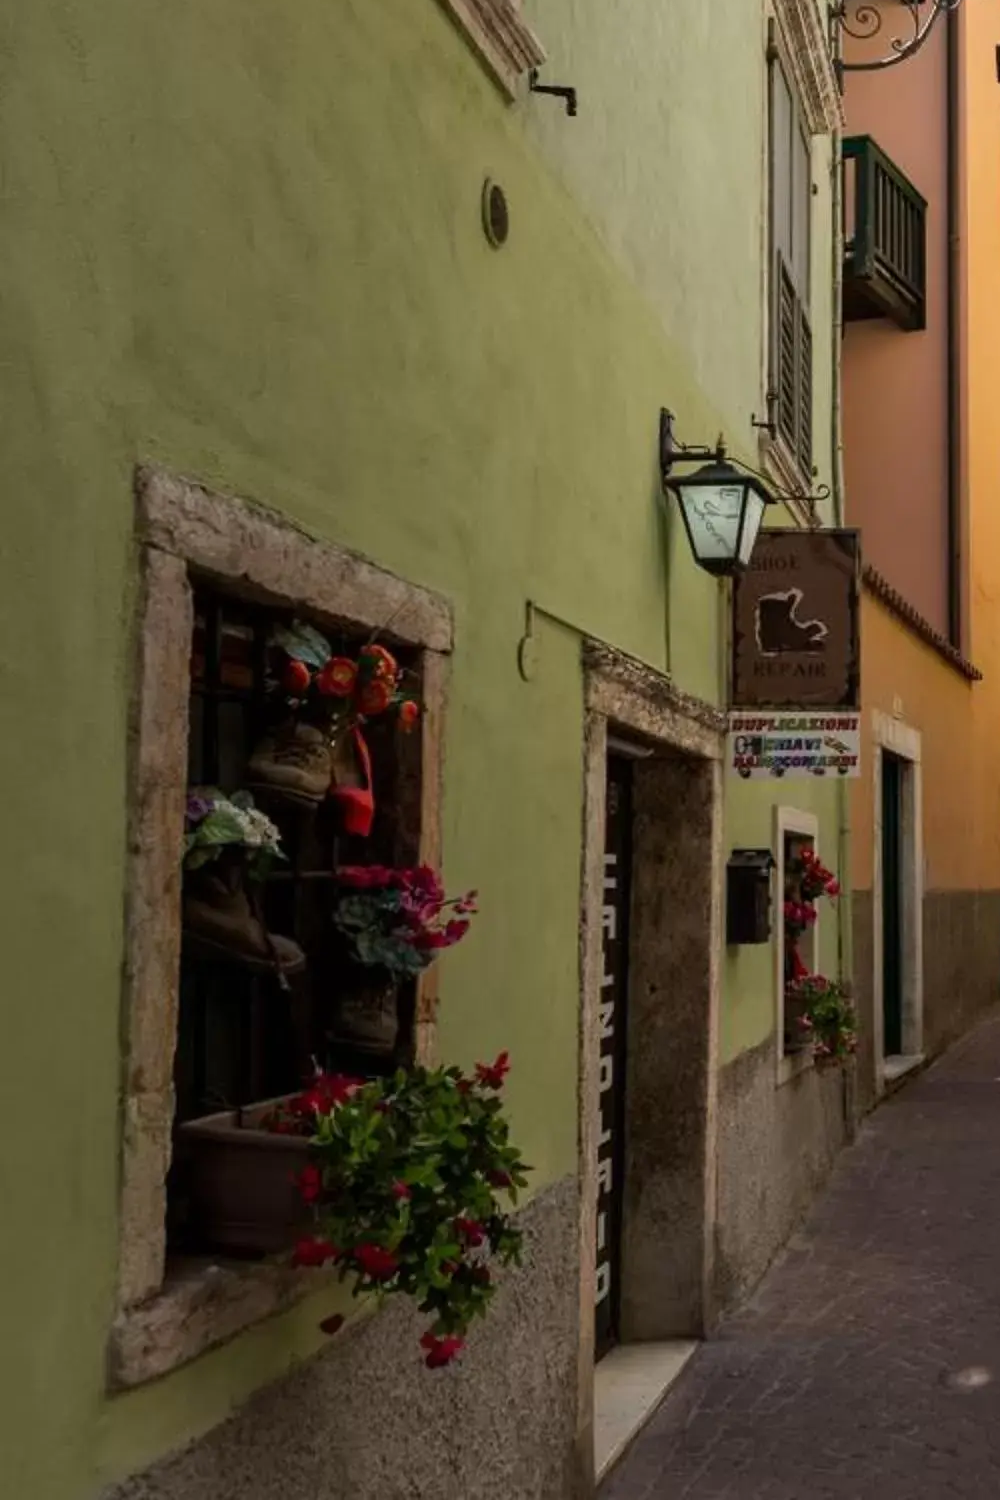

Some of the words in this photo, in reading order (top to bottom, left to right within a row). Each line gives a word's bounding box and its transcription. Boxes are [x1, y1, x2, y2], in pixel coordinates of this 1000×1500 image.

[753, 659, 827, 677] REPAIR
[731, 717, 859, 731] DUPLICAZIONI
[764, 738, 822, 751] CHIAVI
